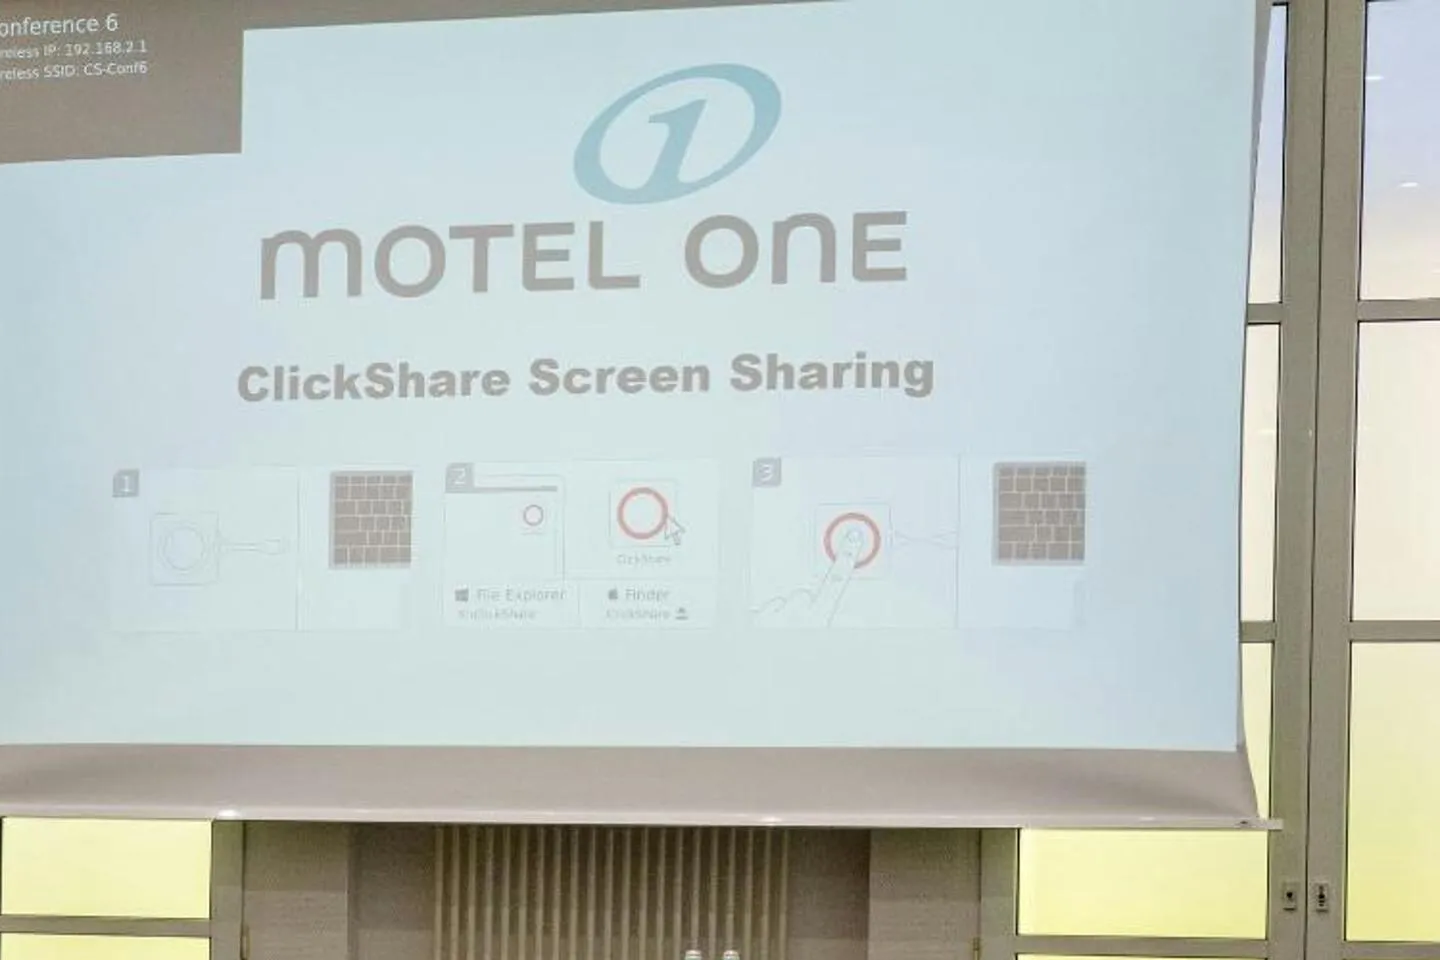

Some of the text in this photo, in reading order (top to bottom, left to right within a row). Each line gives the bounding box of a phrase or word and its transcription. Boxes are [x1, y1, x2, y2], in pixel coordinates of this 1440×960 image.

[105, 13, 119, 32] 6
[43, 43, 61, 57] IP:
[64, 39, 147, 57] 192.168.2.1
[43, 64, 80, 78] SSID:
[83, 60, 149, 77] CS-Conf6
[237, 351, 935, 402] ClickShare Screen Sharing
